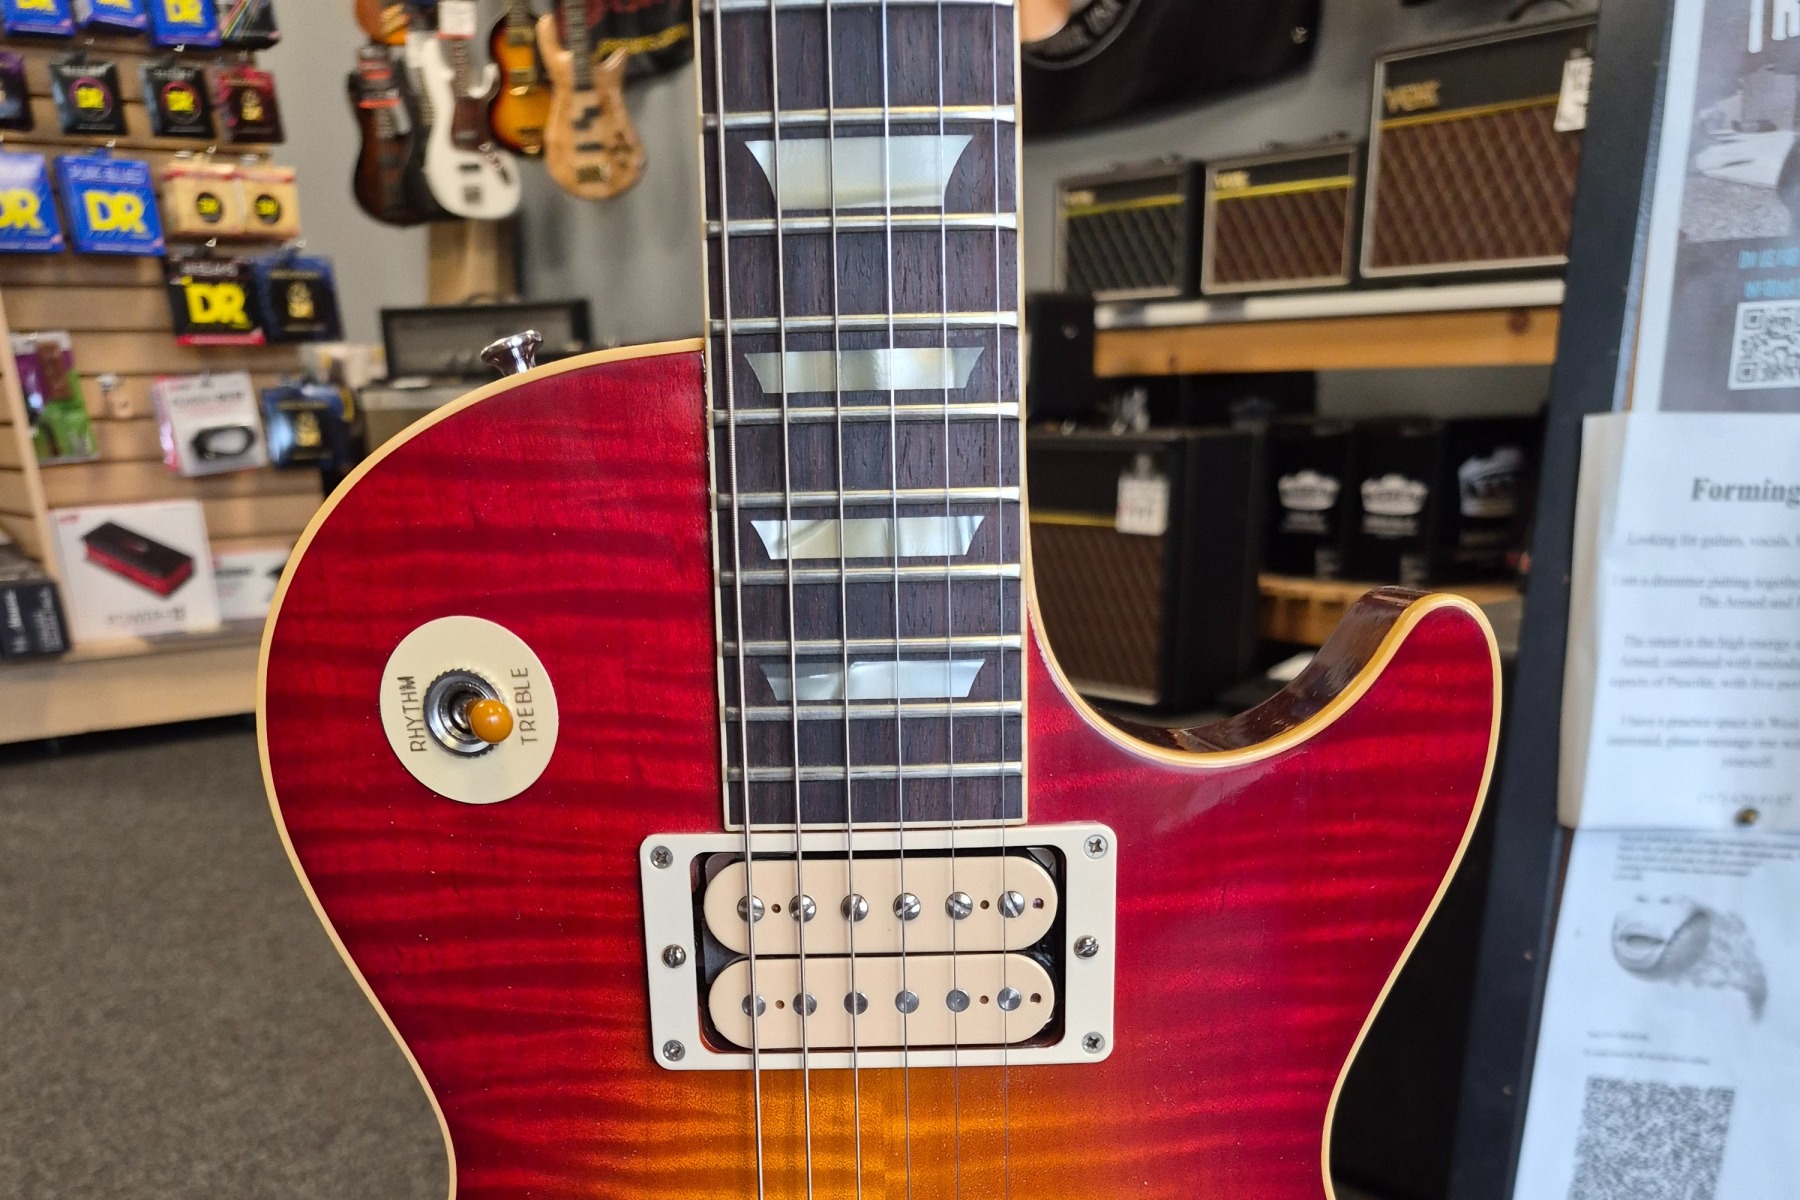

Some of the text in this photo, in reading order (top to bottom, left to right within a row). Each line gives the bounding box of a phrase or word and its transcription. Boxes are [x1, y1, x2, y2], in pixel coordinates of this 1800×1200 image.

[84, 190, 146, 233] DR
[186, 284, 247, 327] DR
[1691, 477, 1800, 509] Forming
[397, 675, 428, 752] RHYTHM
[510, 667, 538, 745] TREBLE
